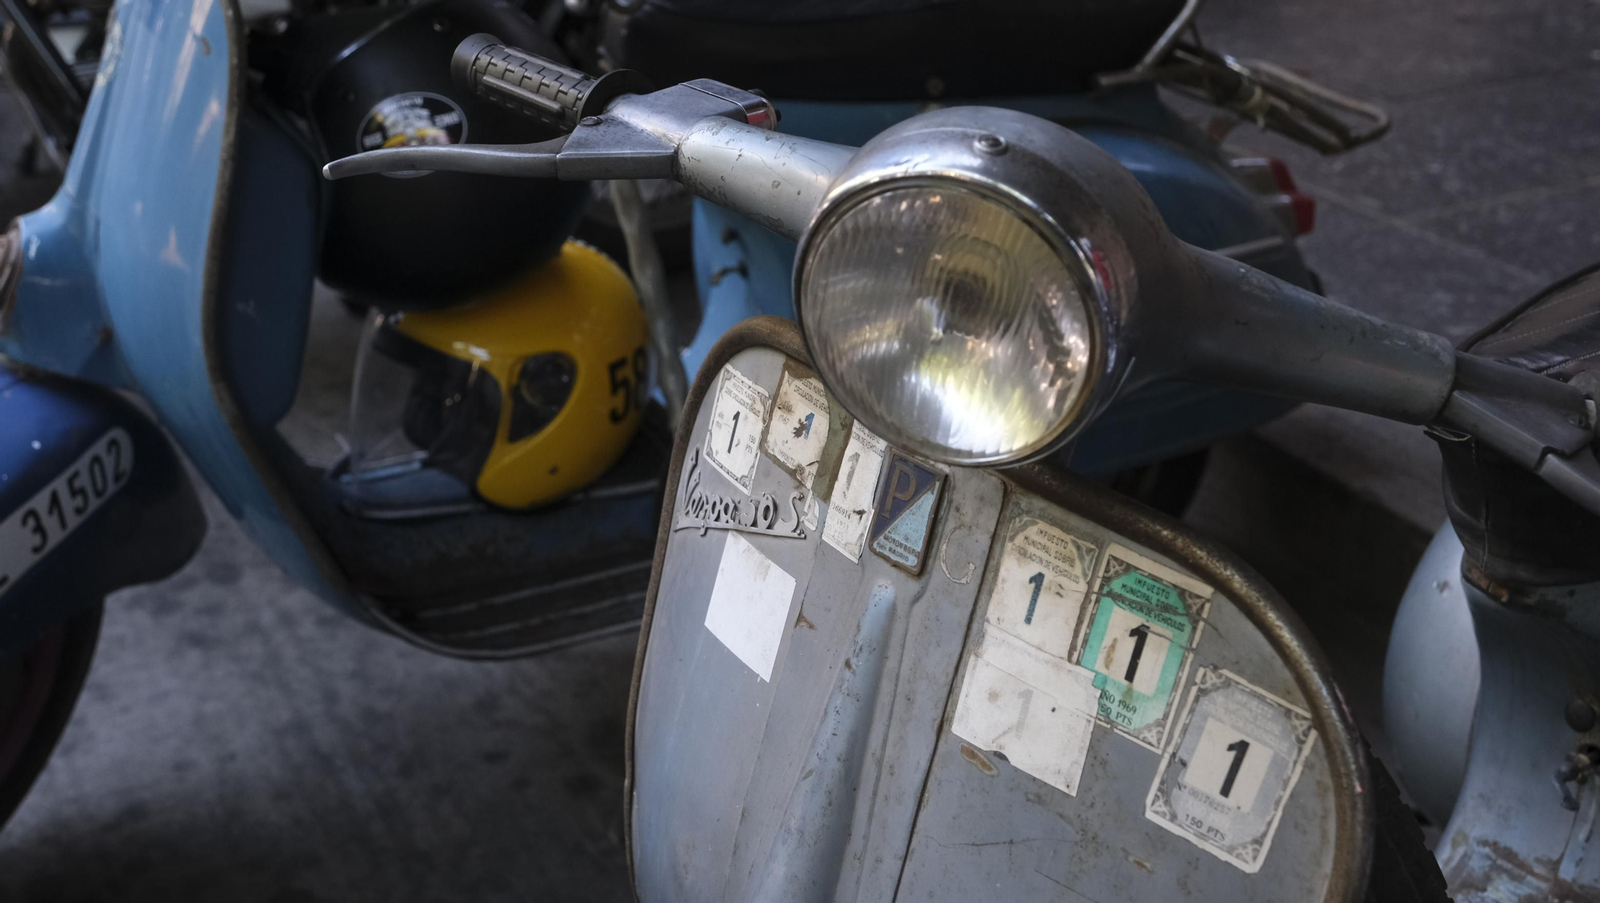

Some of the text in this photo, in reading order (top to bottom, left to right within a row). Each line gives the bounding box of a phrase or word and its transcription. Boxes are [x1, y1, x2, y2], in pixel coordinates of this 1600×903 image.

[727, 410, 741, 454] 1
[803, 412, 815, 440] 1
[847, 451, 861, 499] 1
[880, 461, 917, 520] P
[20, 437, 128, 555] 31502
[1022, 535, 1077, 569] MUNICIPAL SOBRE
[1036, 527, 1069, 550] IMPUESTO
[1024, 571, 1046, 625] 1
[1120, 583, 1154, 605] MUNICIPAL
[1134, 577, 1171, 600] IMPUESTO
[1152, 610, 1186, 633] VEHICULOS
[1124, 623, 1151, 684] 1
[1013, 688, 1035, 741] 1
[1115, 711, 1133, 727] PTS
[1117, 699, 1137, 716] 1969
[1219, 739, 1251, 799] 1
[1185, 813, 1204, 829] 150
[1206, 826, 1227, 841] PTS
